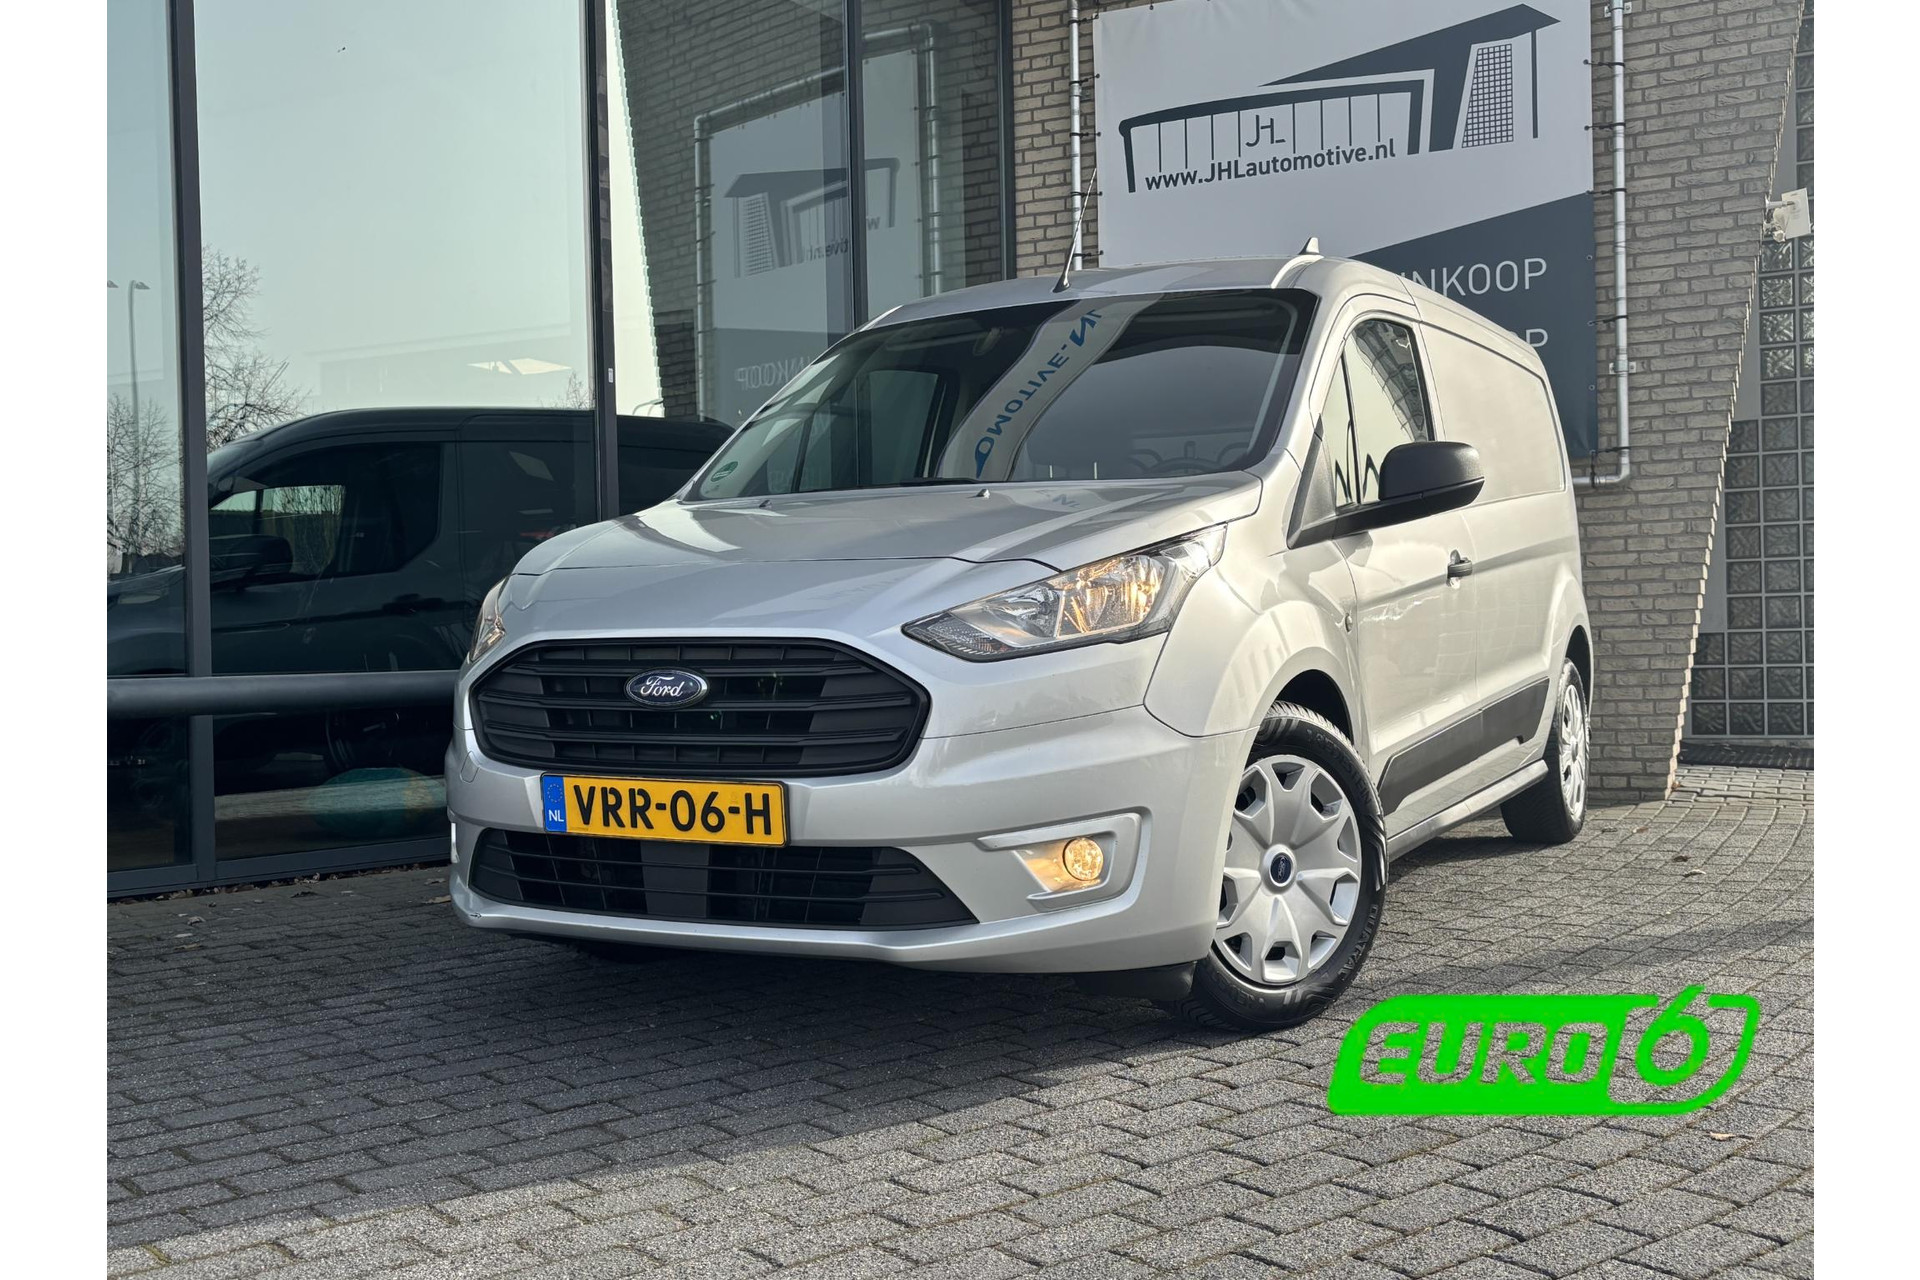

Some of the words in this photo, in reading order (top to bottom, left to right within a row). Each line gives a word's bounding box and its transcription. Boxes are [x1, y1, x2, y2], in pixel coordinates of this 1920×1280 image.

[1145, 138, 1396, 191] www.JHLautomotive.nl
[1401, 257, 1548, 297] NKOOP
[640, 675, 686, 697] Ford
[548, 808, 565, 823] NL
[572, 784, 772, 836] VRR-06-H
